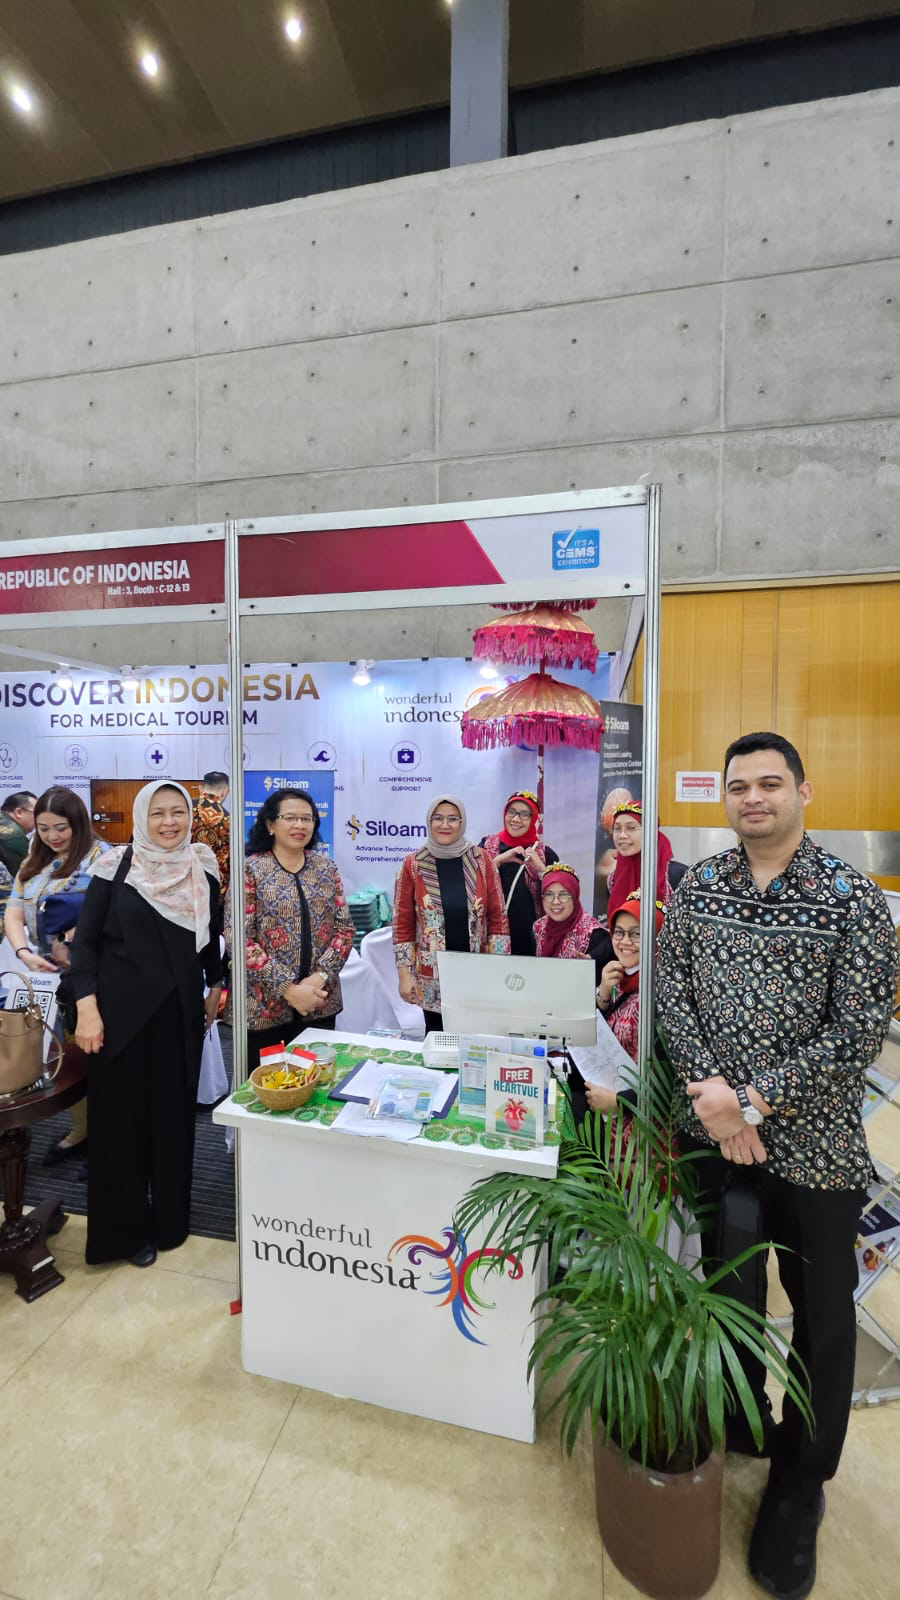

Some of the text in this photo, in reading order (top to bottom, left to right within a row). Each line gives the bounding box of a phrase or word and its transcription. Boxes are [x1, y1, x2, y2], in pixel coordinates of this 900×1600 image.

[0, 559, 190, 590] REPUBLIC OF INDONESIA
[107, 586, 121, 596] Hall
[134, 584, 154, 595] Booth
[159, 584, 174, 593] C-12
[0, 680, 125, 708] ISCOVER
[384, 692, 453, 705] wonderful
[50, 709, 258, 728] FOR MEDICAL TOURIM
[384, 706, 464, 723] indones
[610, 716, 630, 731] Siloam
[272, 777, 309, 789] Siloam
[365, 820, 427, 838] Siloam
[355, 855, 405, 863] Comprehensiv
[29, 976, 52, 986] Siloam
[505, 1069, 529, 1082] FREE
[493, 1079, 539, 1098] HEARTVUE
[252, 1213, 372, 1249] wonderful
[252, 1239, 422, 1291] indonesia
